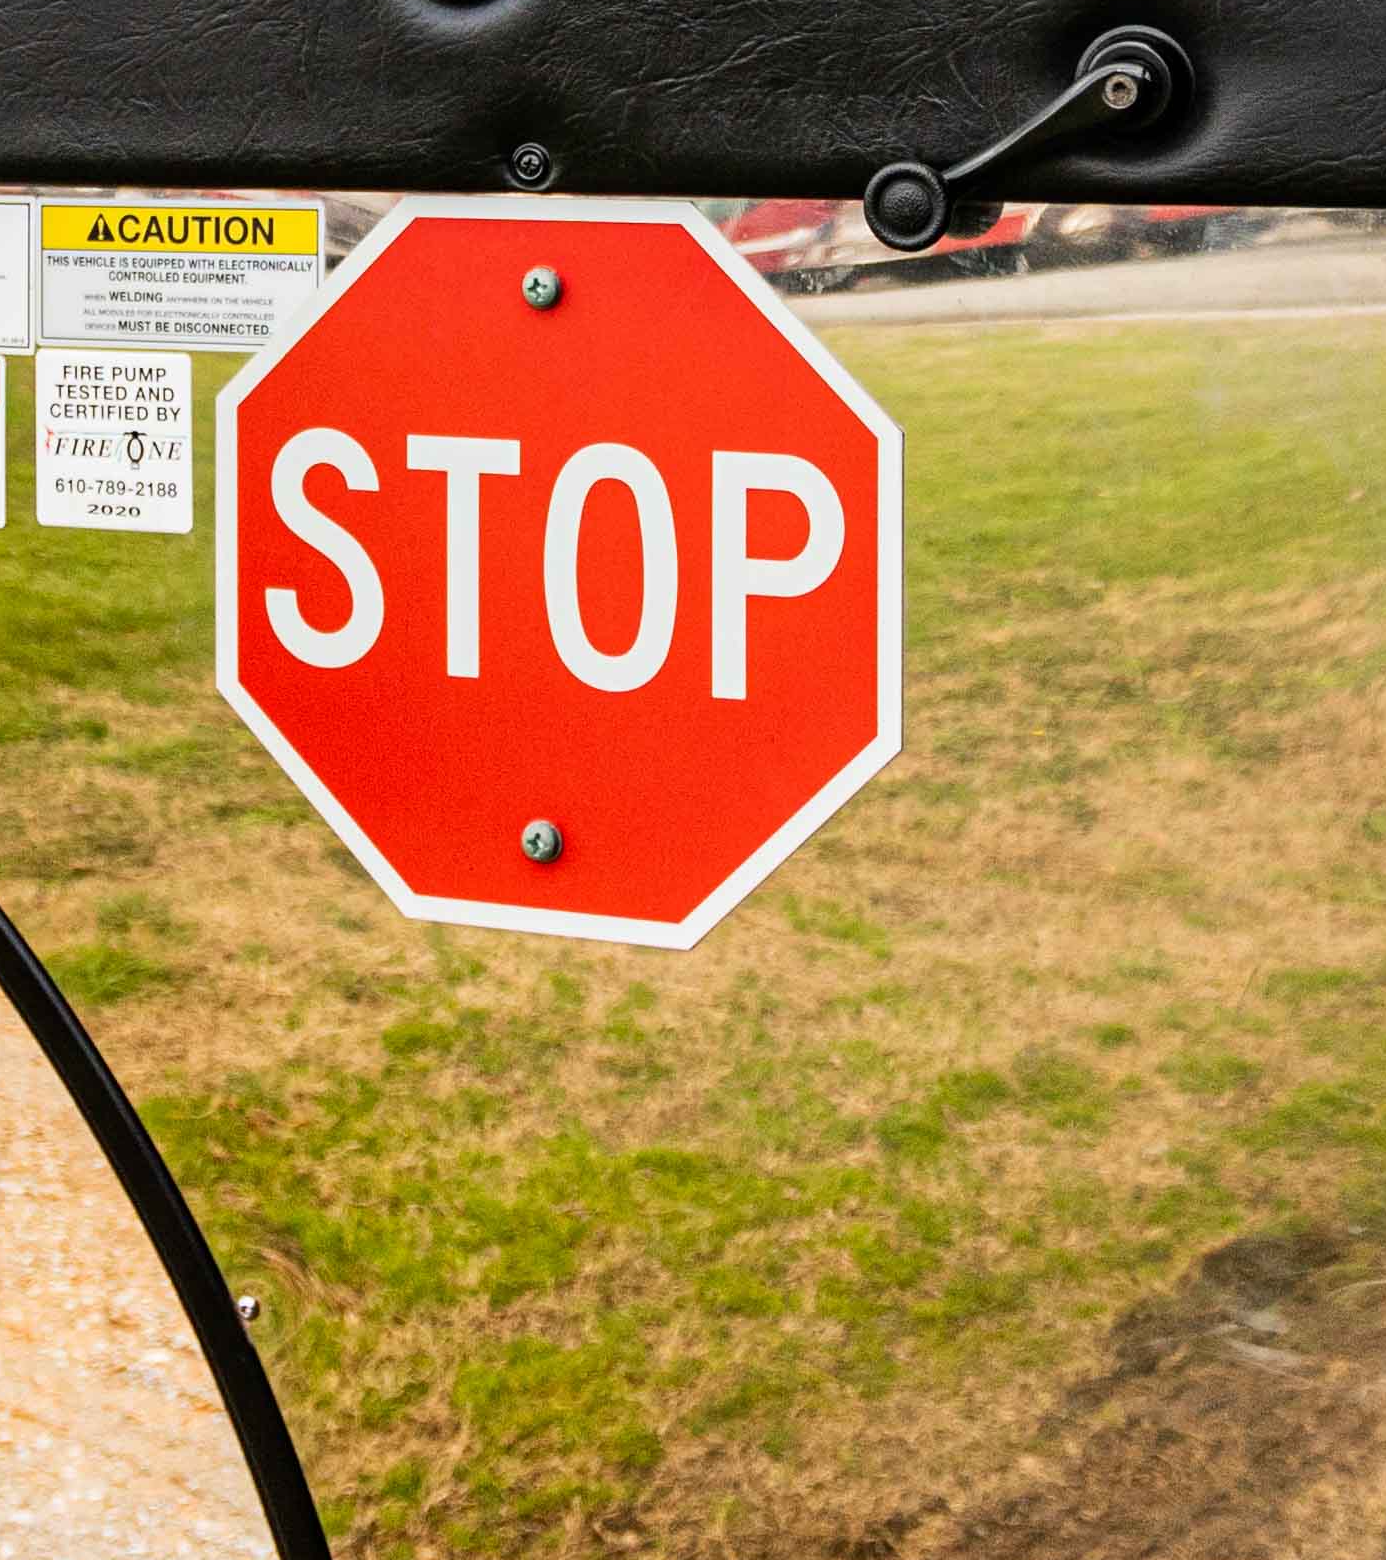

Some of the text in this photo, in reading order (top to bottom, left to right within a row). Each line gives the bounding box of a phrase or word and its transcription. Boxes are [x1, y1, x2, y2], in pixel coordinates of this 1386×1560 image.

[118, 214, 274, 245] CAUTION
[47, 256, 313, 272] THIS VEHICLE IS EQUIPPED WITH ELECTRONICALLY
[109, 271, 248, 285] CONTROLLED EQUIPMENT.
[109, 291, 163, 303] WELDING
[118, 321, 151, 332] MUST
[155, 322, 170, 333] BE
[174, 323, 272, 335] DISCONNECTED.
[63, 365, 166, 382] FIRE PUMP
[55, 384, 175, 402] TESTED AND
[49, 403, 182, 422] CERTIFIED BY
[55, 477, 178, 498] 610-789-2188
[87, 503, 142, 518] 2020
[265, 427, 846, 701] STOP
